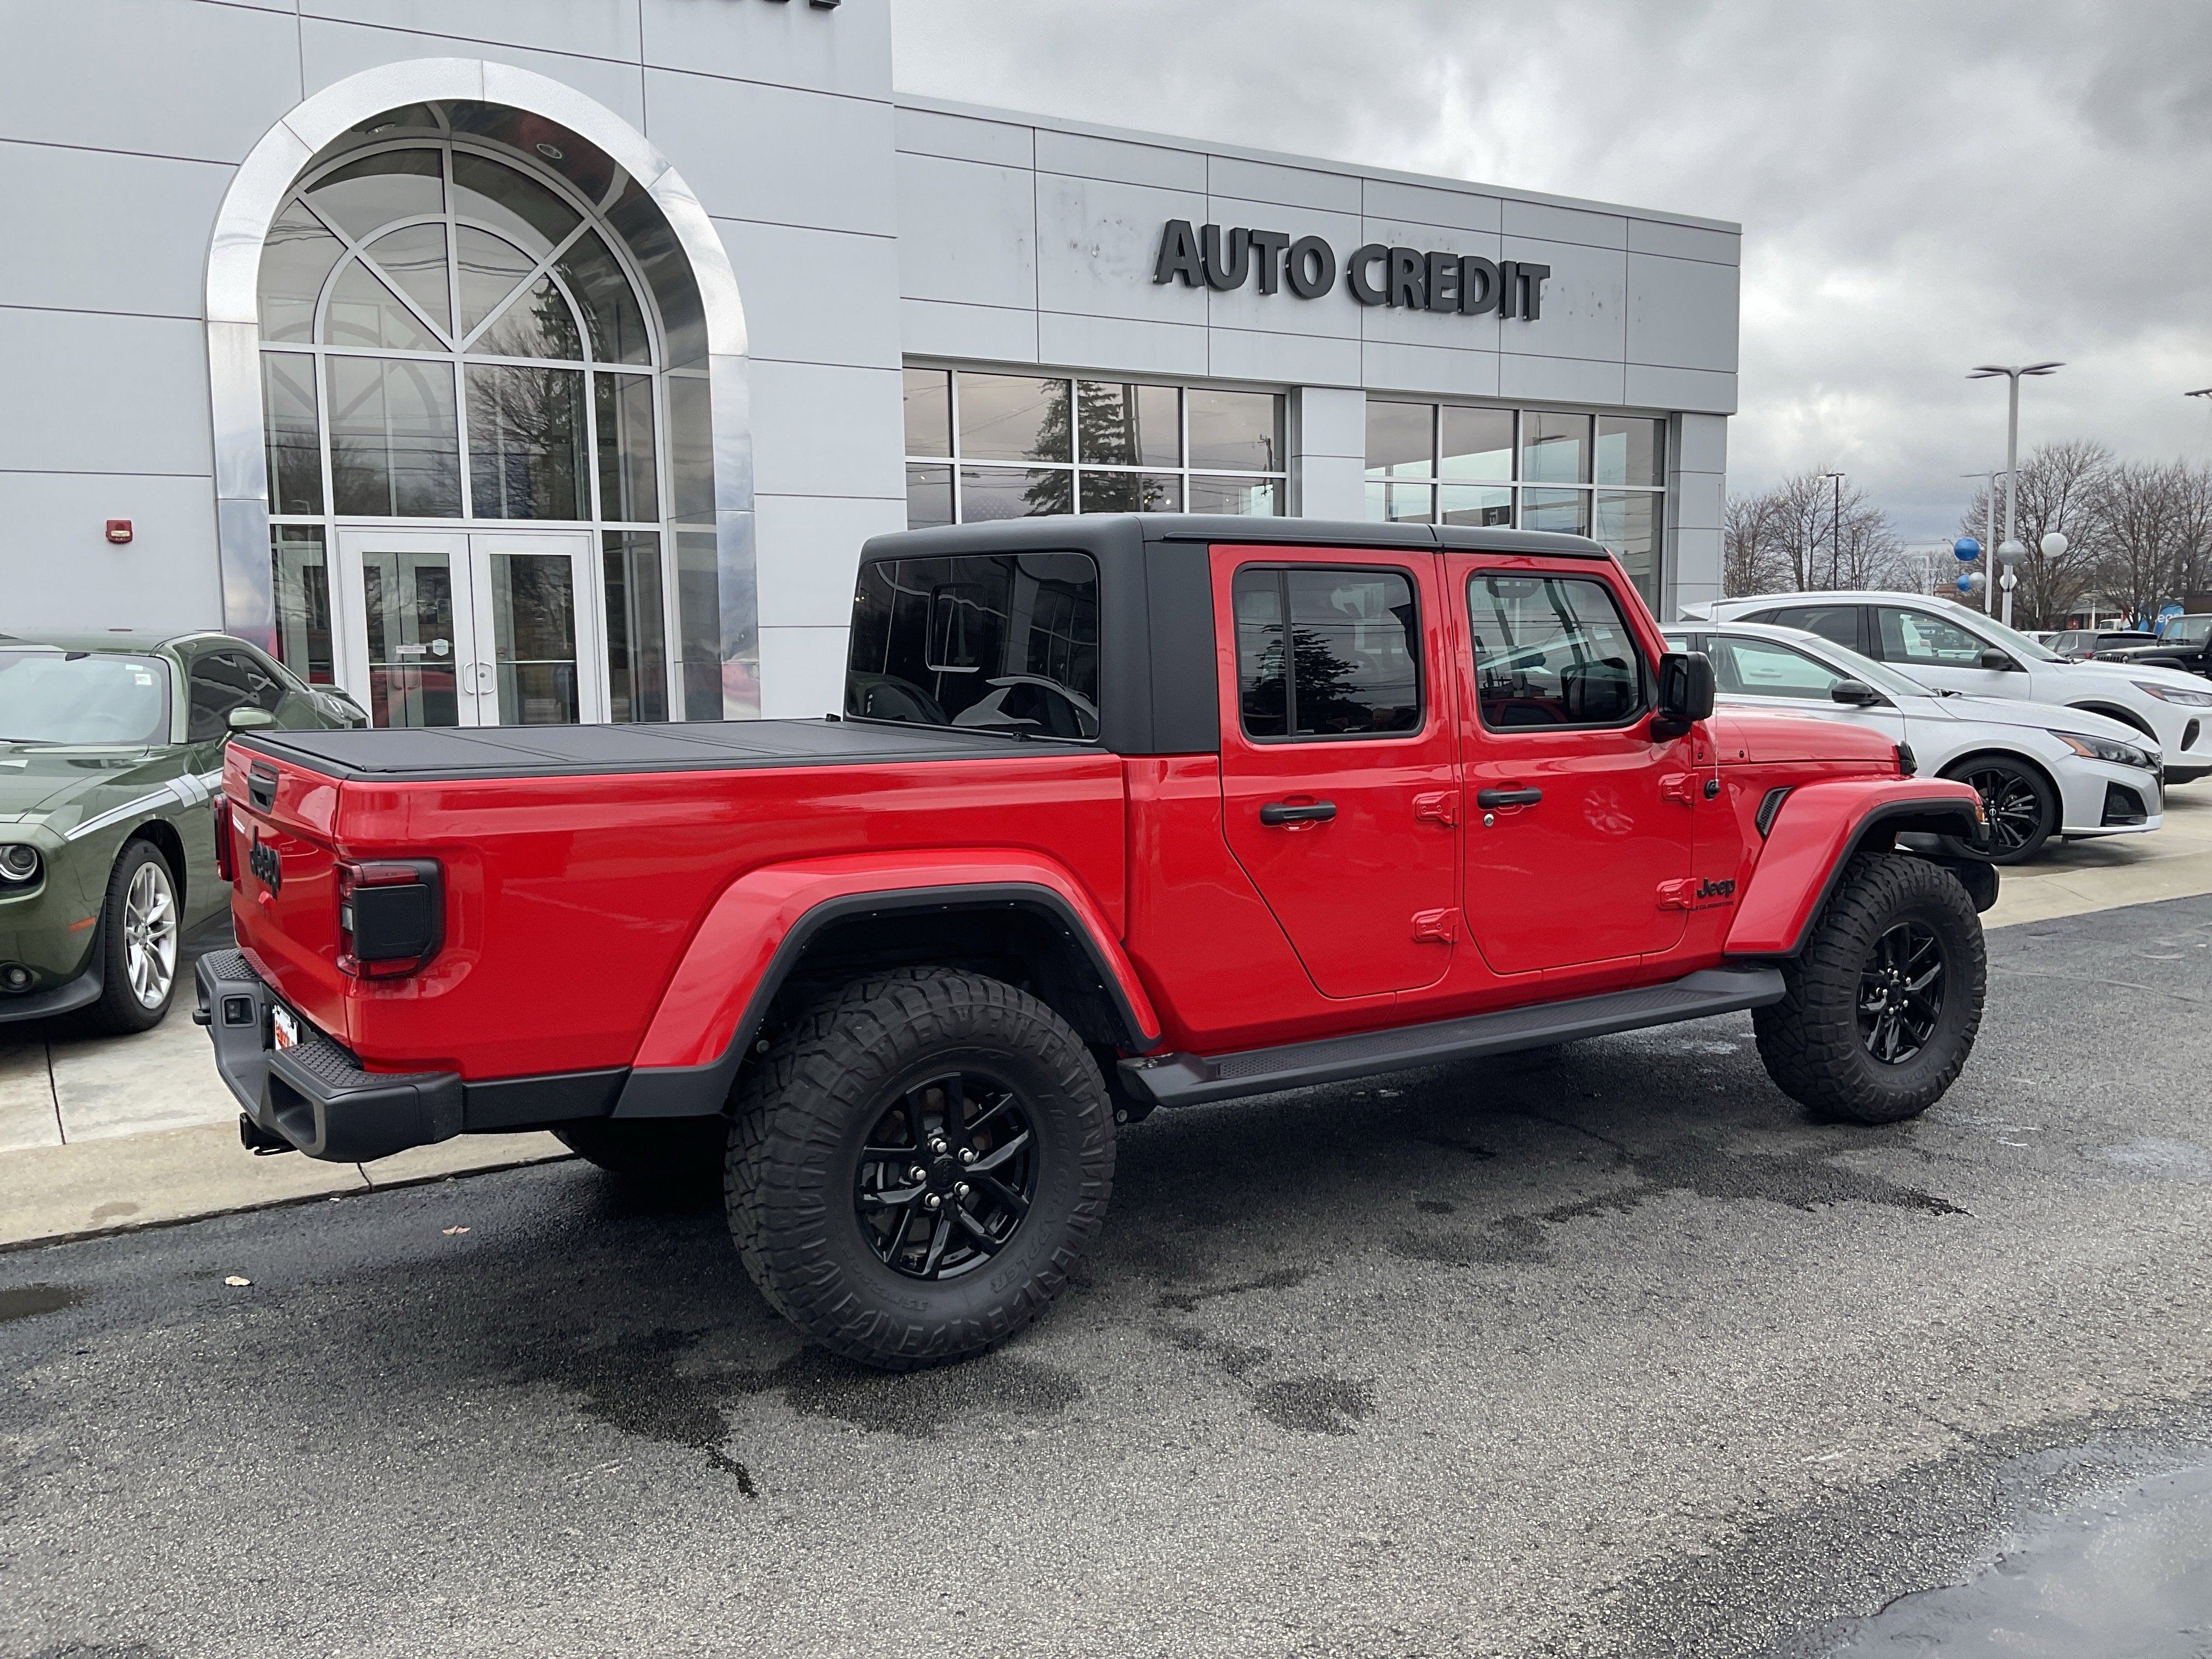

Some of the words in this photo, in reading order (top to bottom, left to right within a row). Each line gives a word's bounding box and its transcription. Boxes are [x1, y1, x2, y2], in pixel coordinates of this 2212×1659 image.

[1153, 219, 1336, 300] AUTO
[1347, 243, 1551, 321] CREDIT
[250, 825, 282, 901] Jeep
[1696, 877, 1736, 899] Jeep
